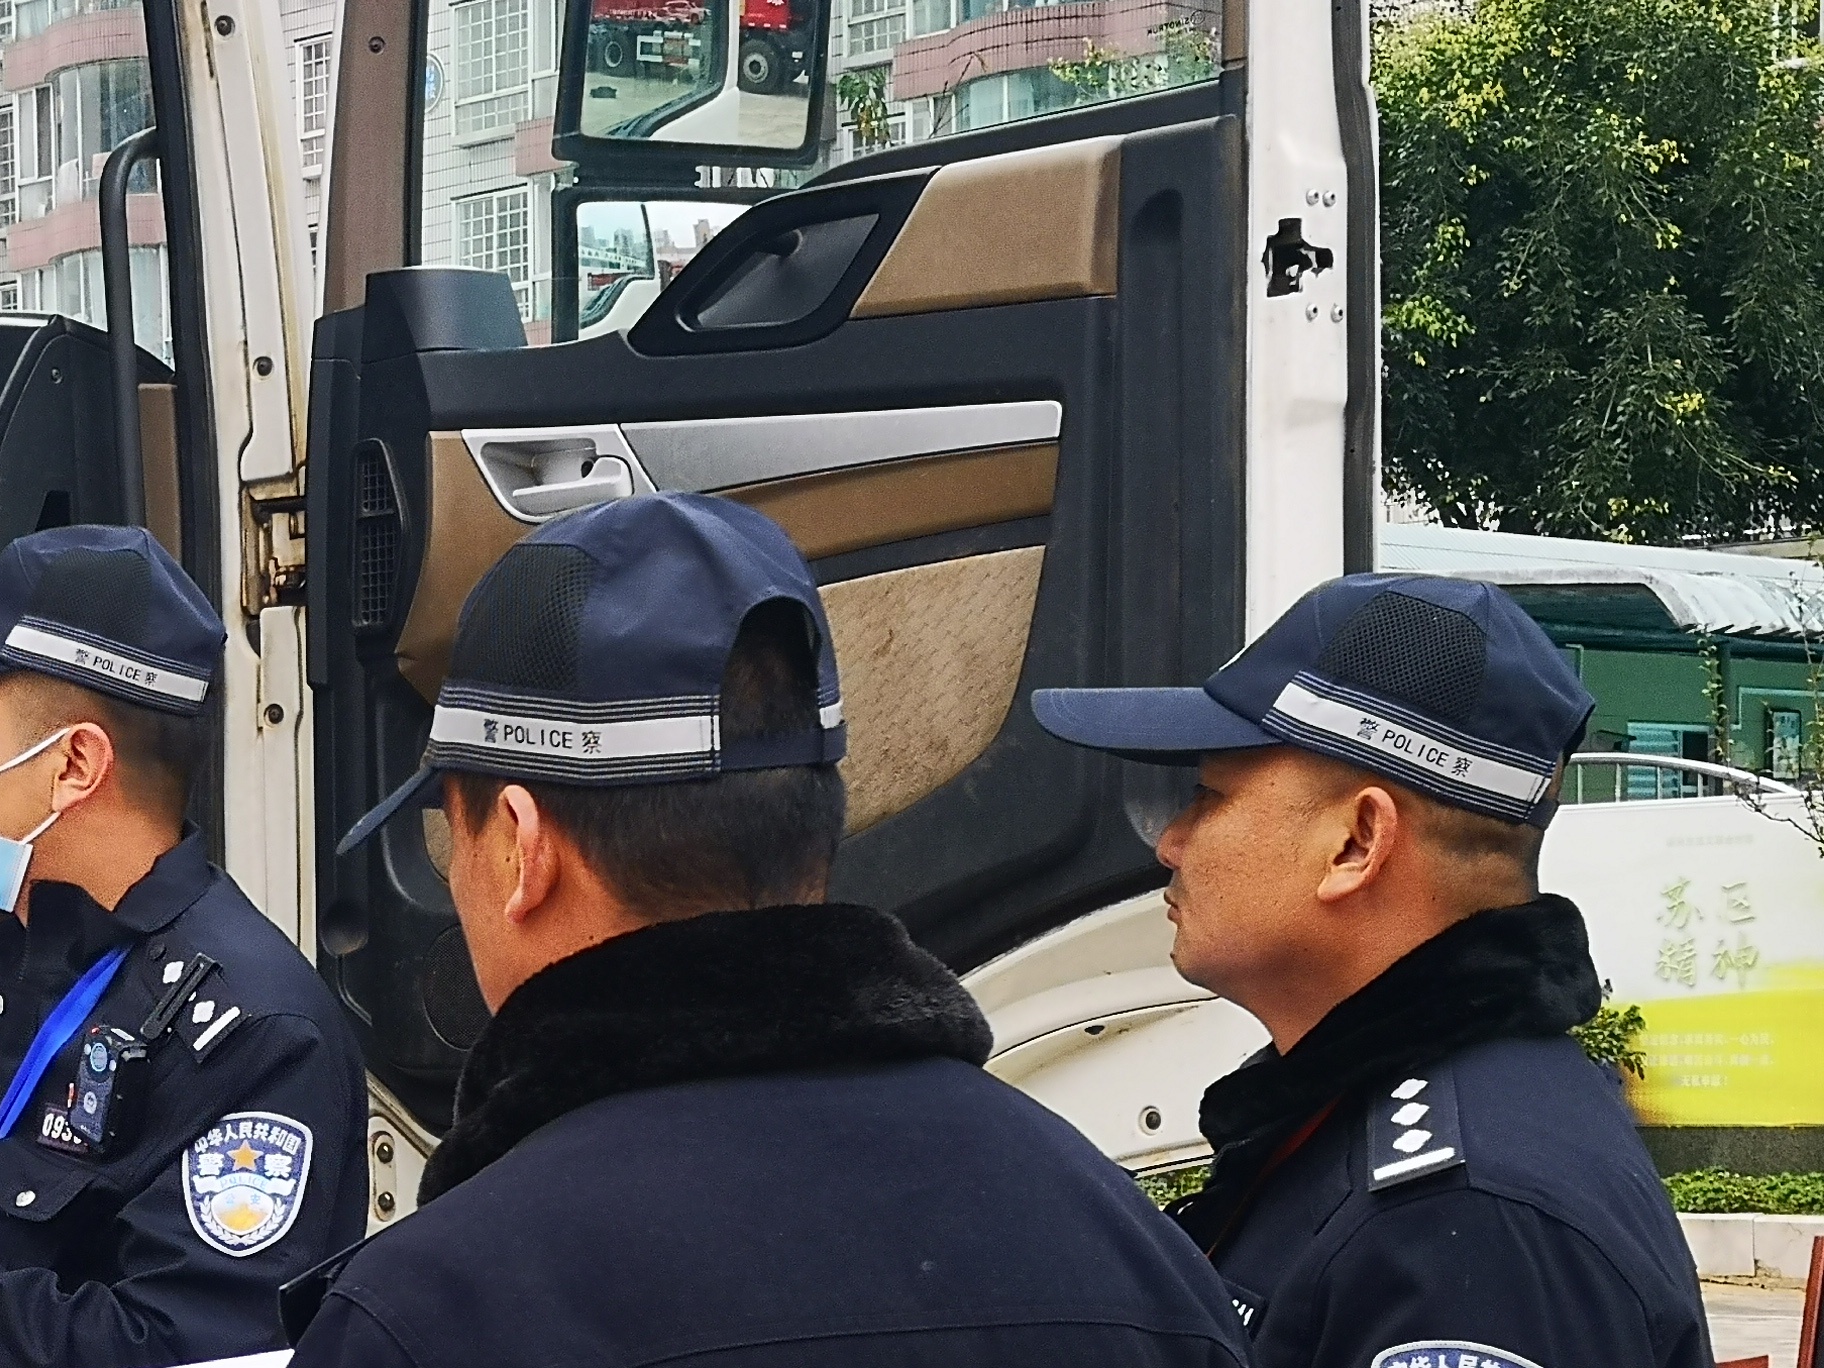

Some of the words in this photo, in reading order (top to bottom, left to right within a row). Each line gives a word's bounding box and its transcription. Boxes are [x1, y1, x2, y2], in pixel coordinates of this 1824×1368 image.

[93, 655, 141, 681] POLICE
[503, 724, 573, 749] POLICE
[1381, 729, 1449, 767] POLICE
[1451, 756, 1473, 777] 察
[194, 1121, 302, 1156] 中华人民共和国
[219, 1173, 268, 1190] POLICE
